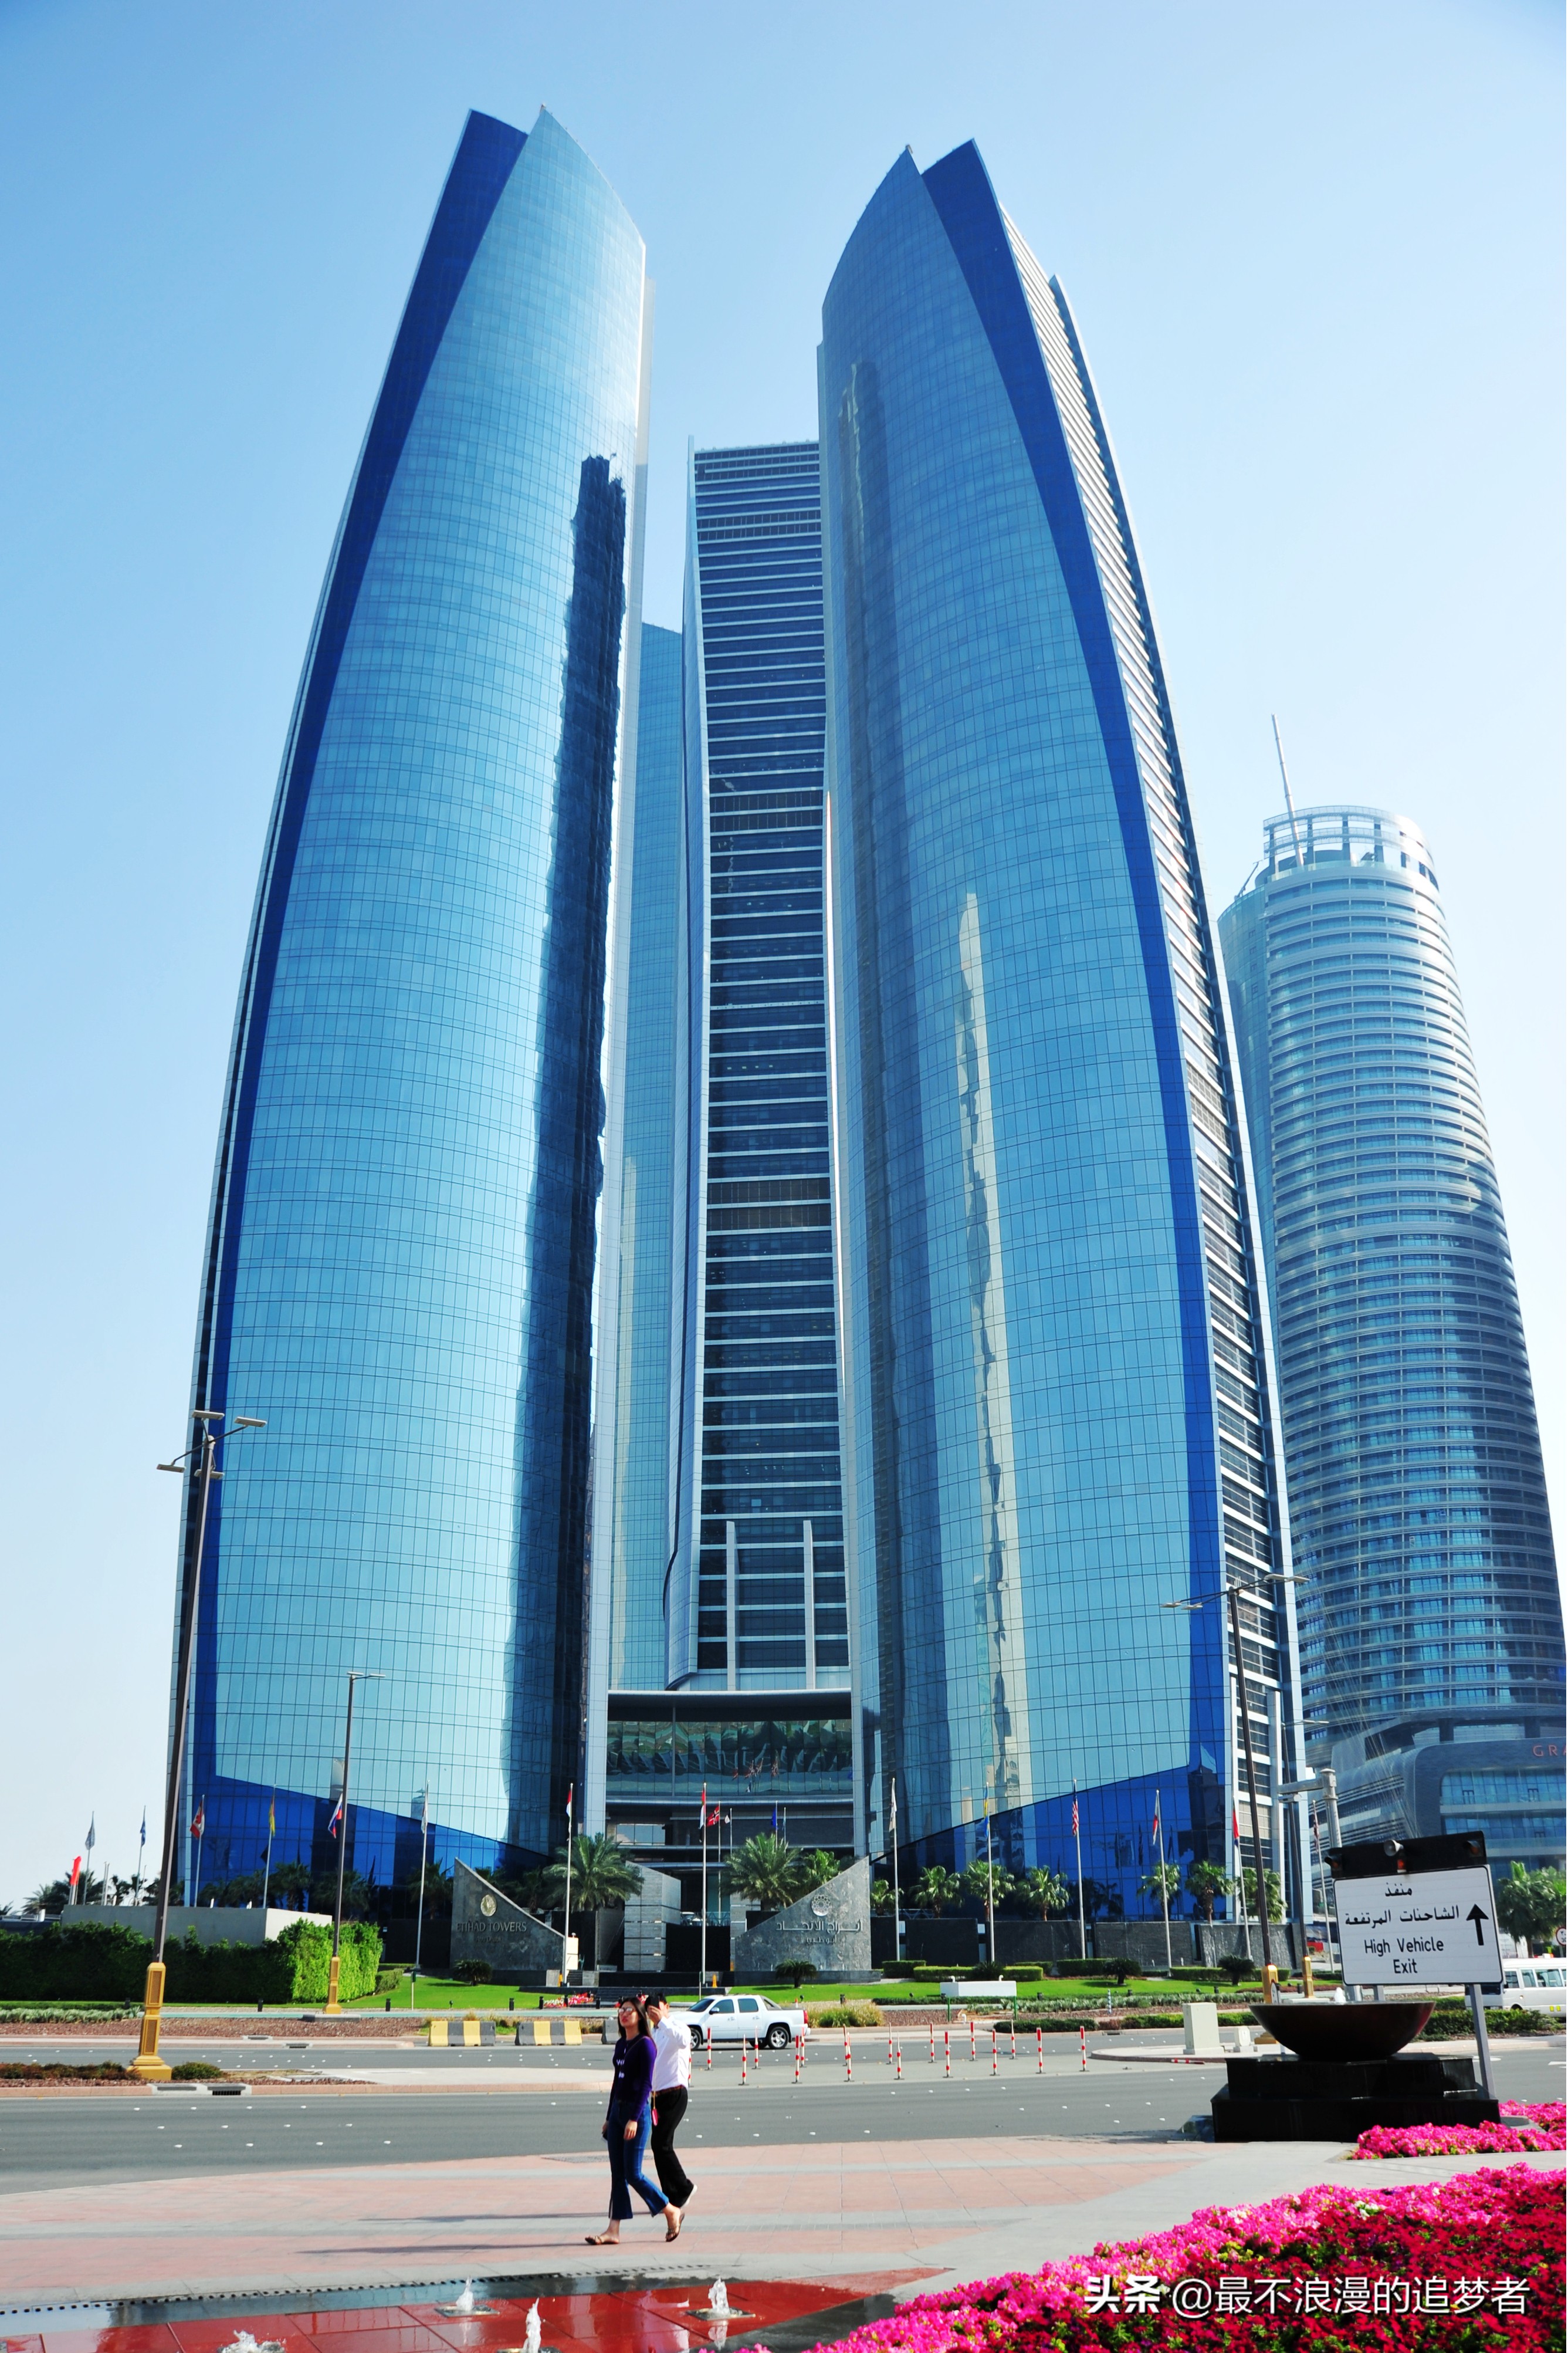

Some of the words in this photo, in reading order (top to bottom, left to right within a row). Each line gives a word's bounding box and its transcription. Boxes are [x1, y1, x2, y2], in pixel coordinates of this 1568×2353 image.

[1384, 1882, 1413, 1897] منفذ
[1345, 1909, 1391, 1929] المرتفعة
[1399, 1904, 1459, 1922] الشاحنات
[456, 1921, 486, 1932] ETIHAD
[488, 1921, 527, 1932] TOWERS
[1364, 1938, 1391, 1957] High
[1396, 1936, 1444, 1953] Vehicle
[1393, 1958, 1418, 1974] Exit
